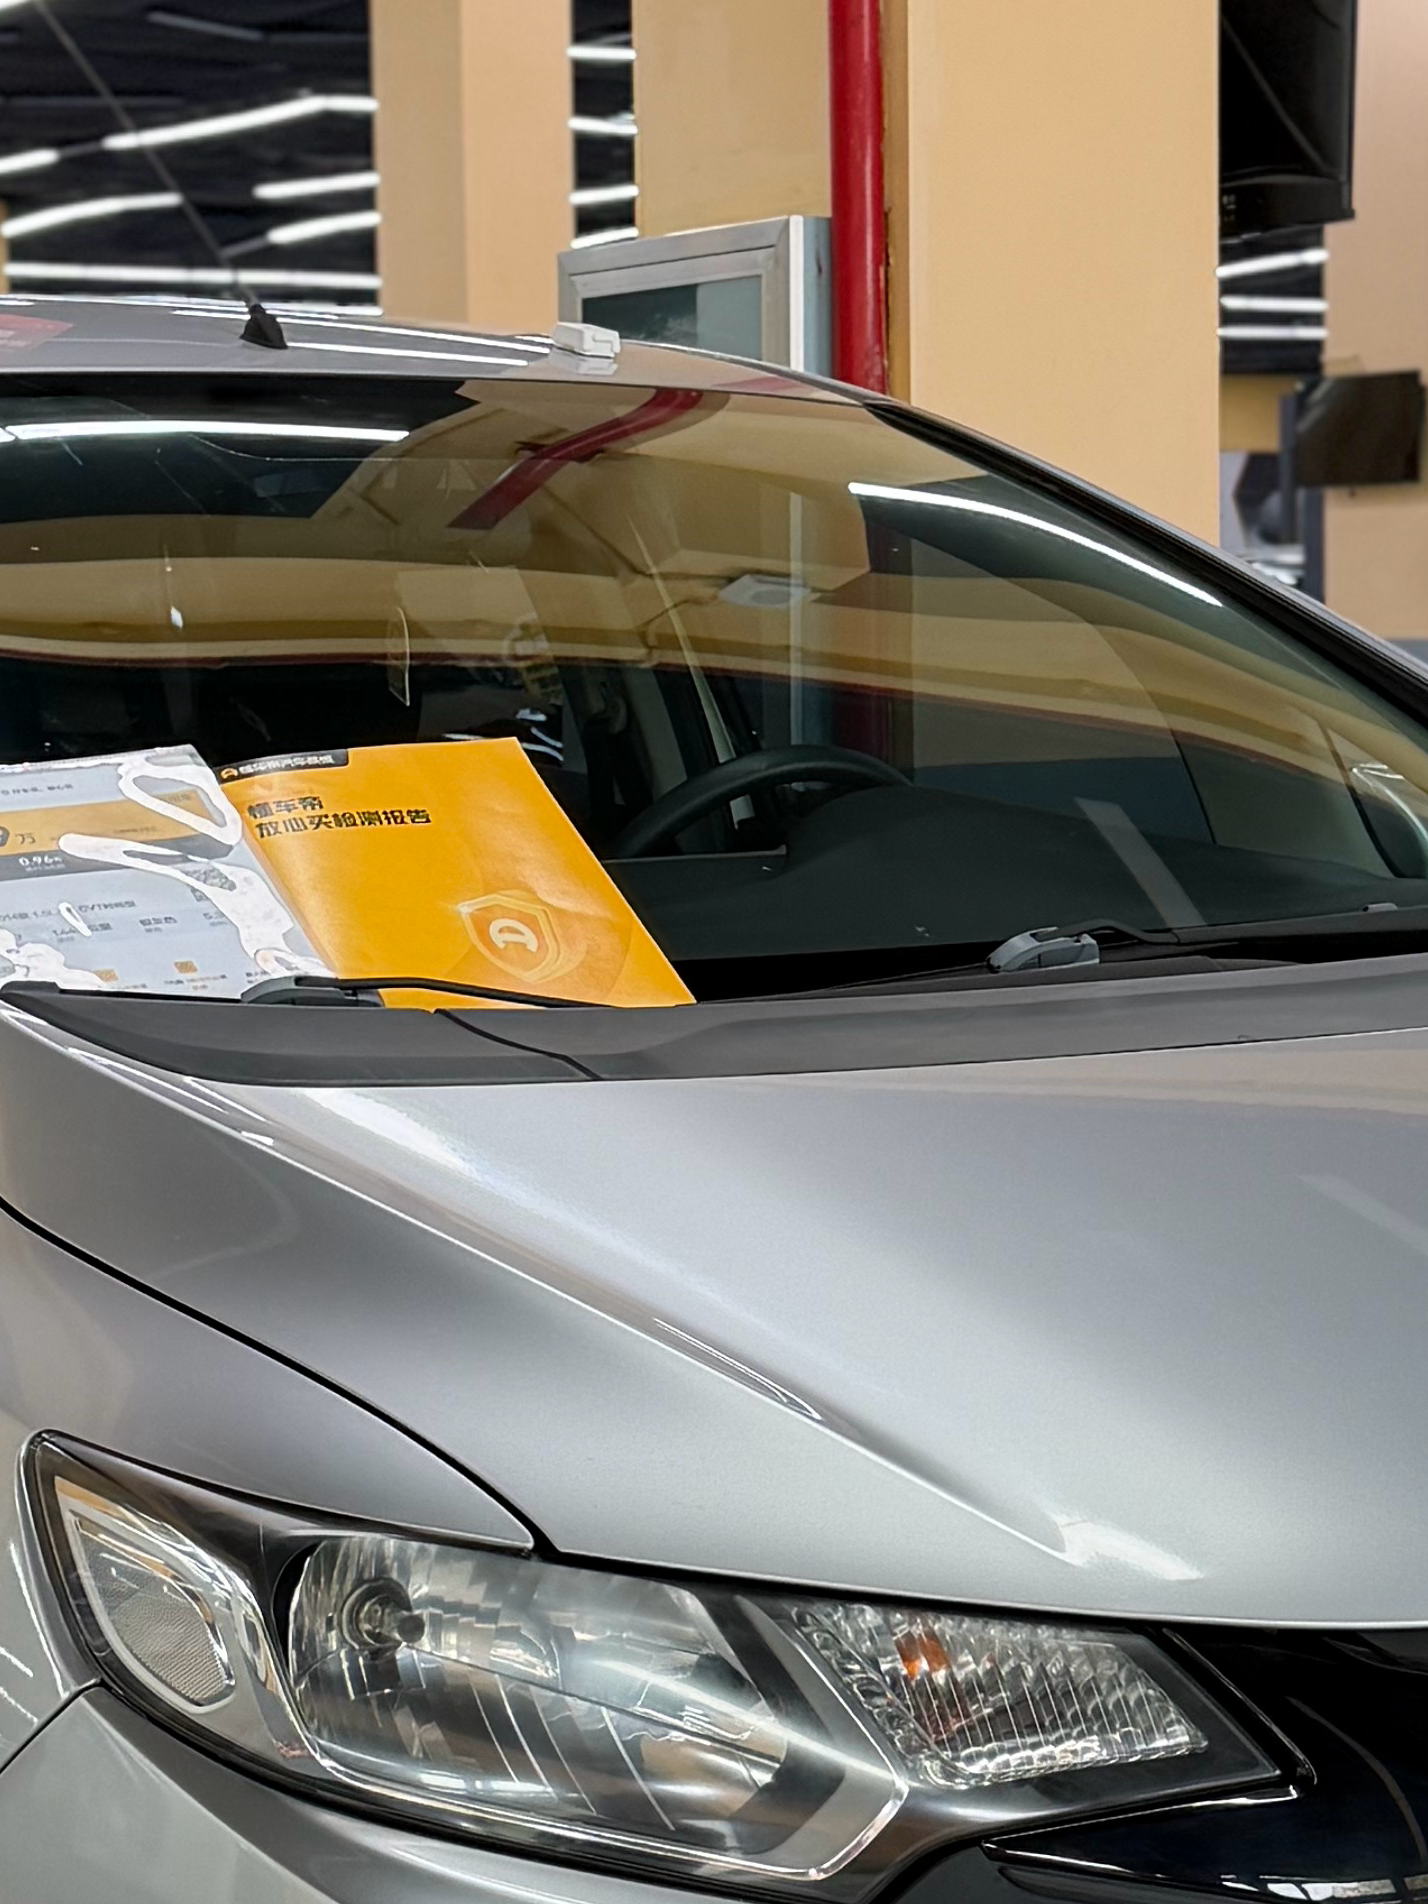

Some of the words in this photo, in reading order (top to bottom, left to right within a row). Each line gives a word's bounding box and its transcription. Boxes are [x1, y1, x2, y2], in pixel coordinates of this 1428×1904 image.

[247, 796, 324, 820] 懂车帝
[255, 809, 432, 839] 放心买检测报告
